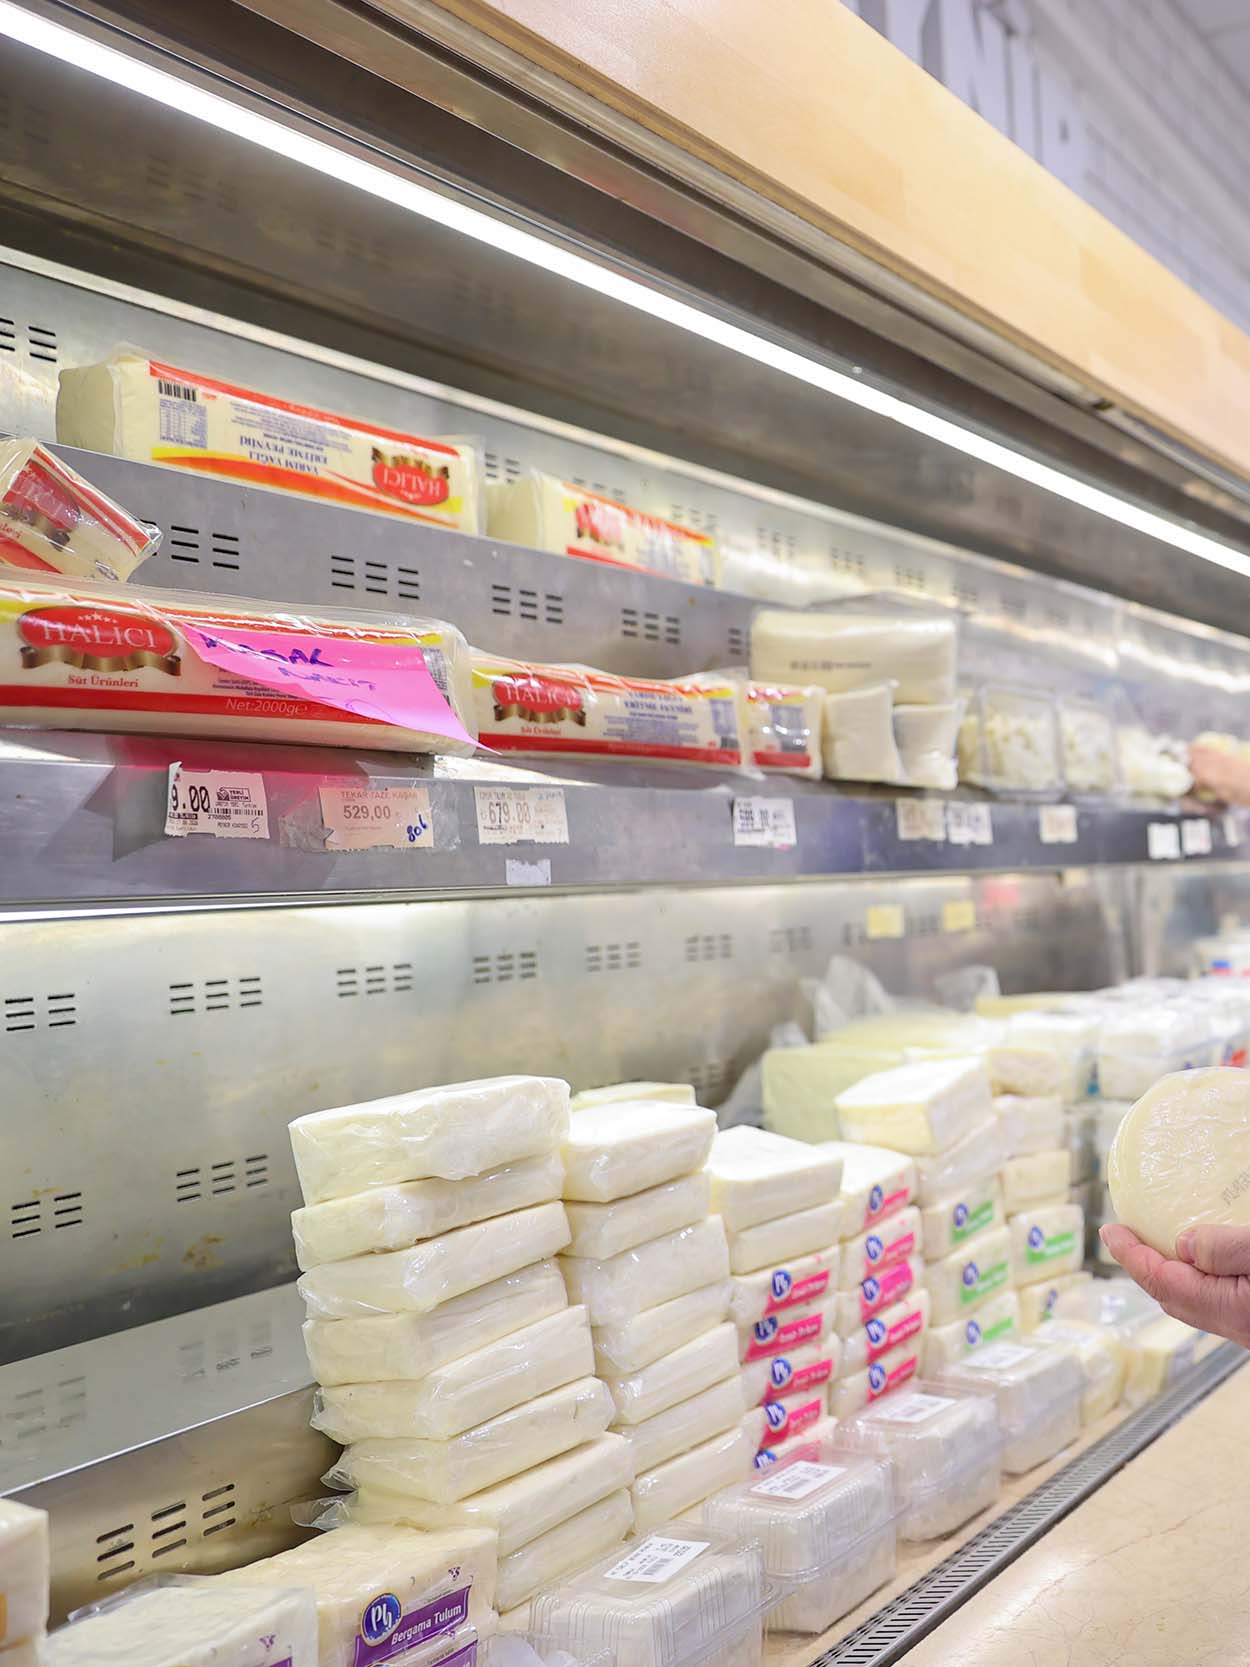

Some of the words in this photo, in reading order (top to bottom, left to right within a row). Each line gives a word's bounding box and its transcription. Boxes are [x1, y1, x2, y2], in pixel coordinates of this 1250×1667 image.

[383, 467, 441, 498] HALICI
[40, 619, 158, 648] HALICI
[68, 674, 88, 686] Süt
[90, 674, 139, 688] Ürünleri
[343, 804, 391, 821] 529,00
[391, 1618, 432, 1645] Bergama
[433, 1604, 462, 1624] Tulum
